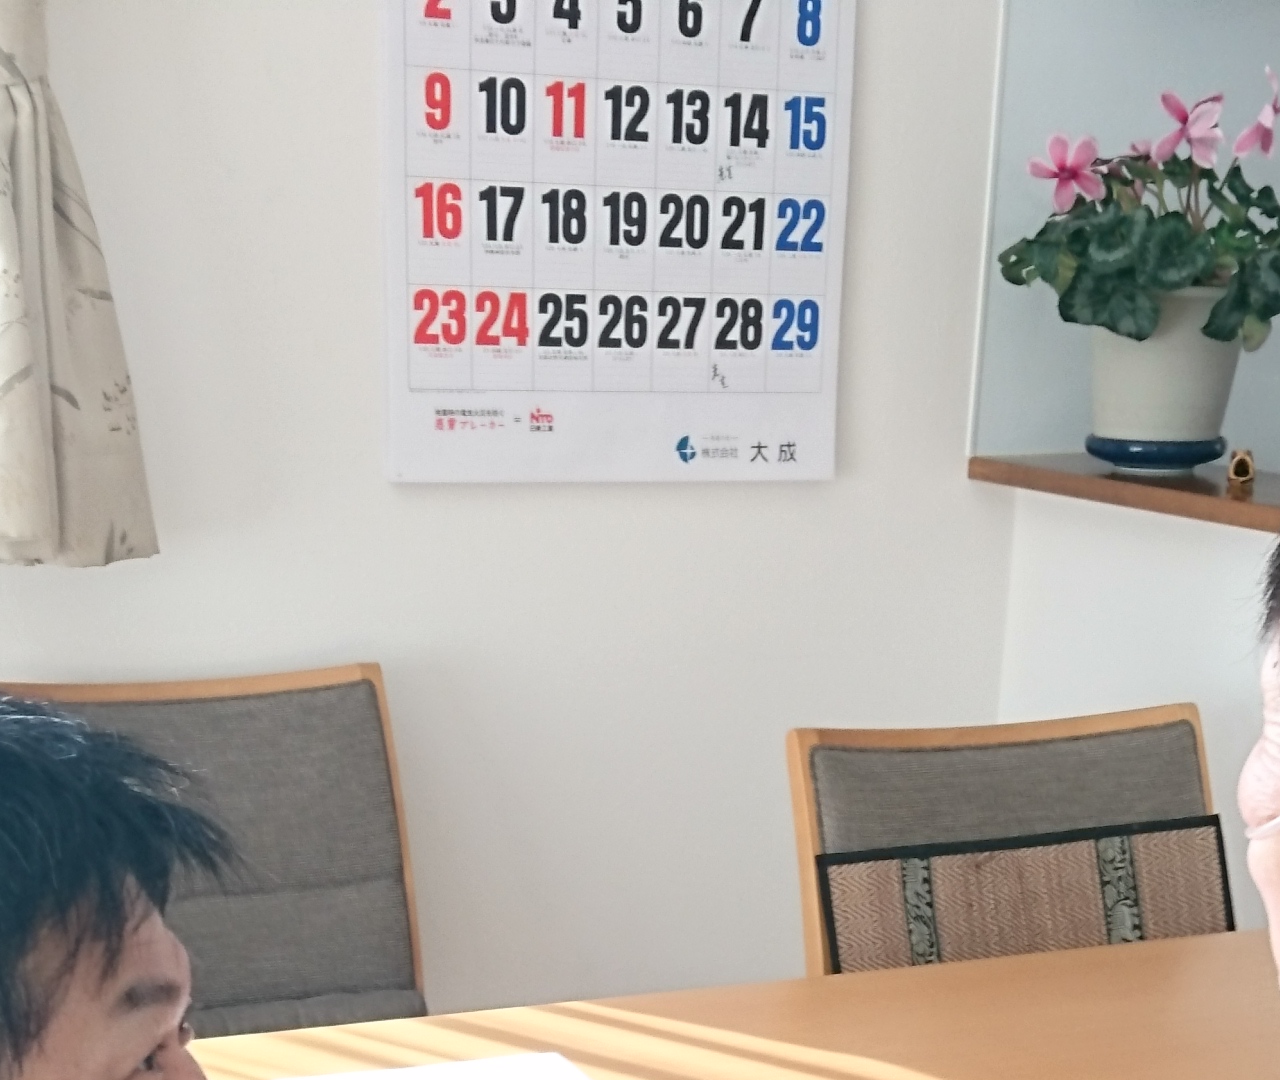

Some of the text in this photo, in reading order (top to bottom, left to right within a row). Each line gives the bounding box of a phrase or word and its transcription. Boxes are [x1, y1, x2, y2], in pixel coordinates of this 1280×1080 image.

[679, 0, 702, 37] 6
[797, 0, 821, 46] 8
[426, 73, 826, 150] 9 10 11 12 13 14 15
[416, 183, 825, 252] 16 17 18 19 20 21 22
[414, 289, 819, 350] 23 24 25 26 27 28 29
